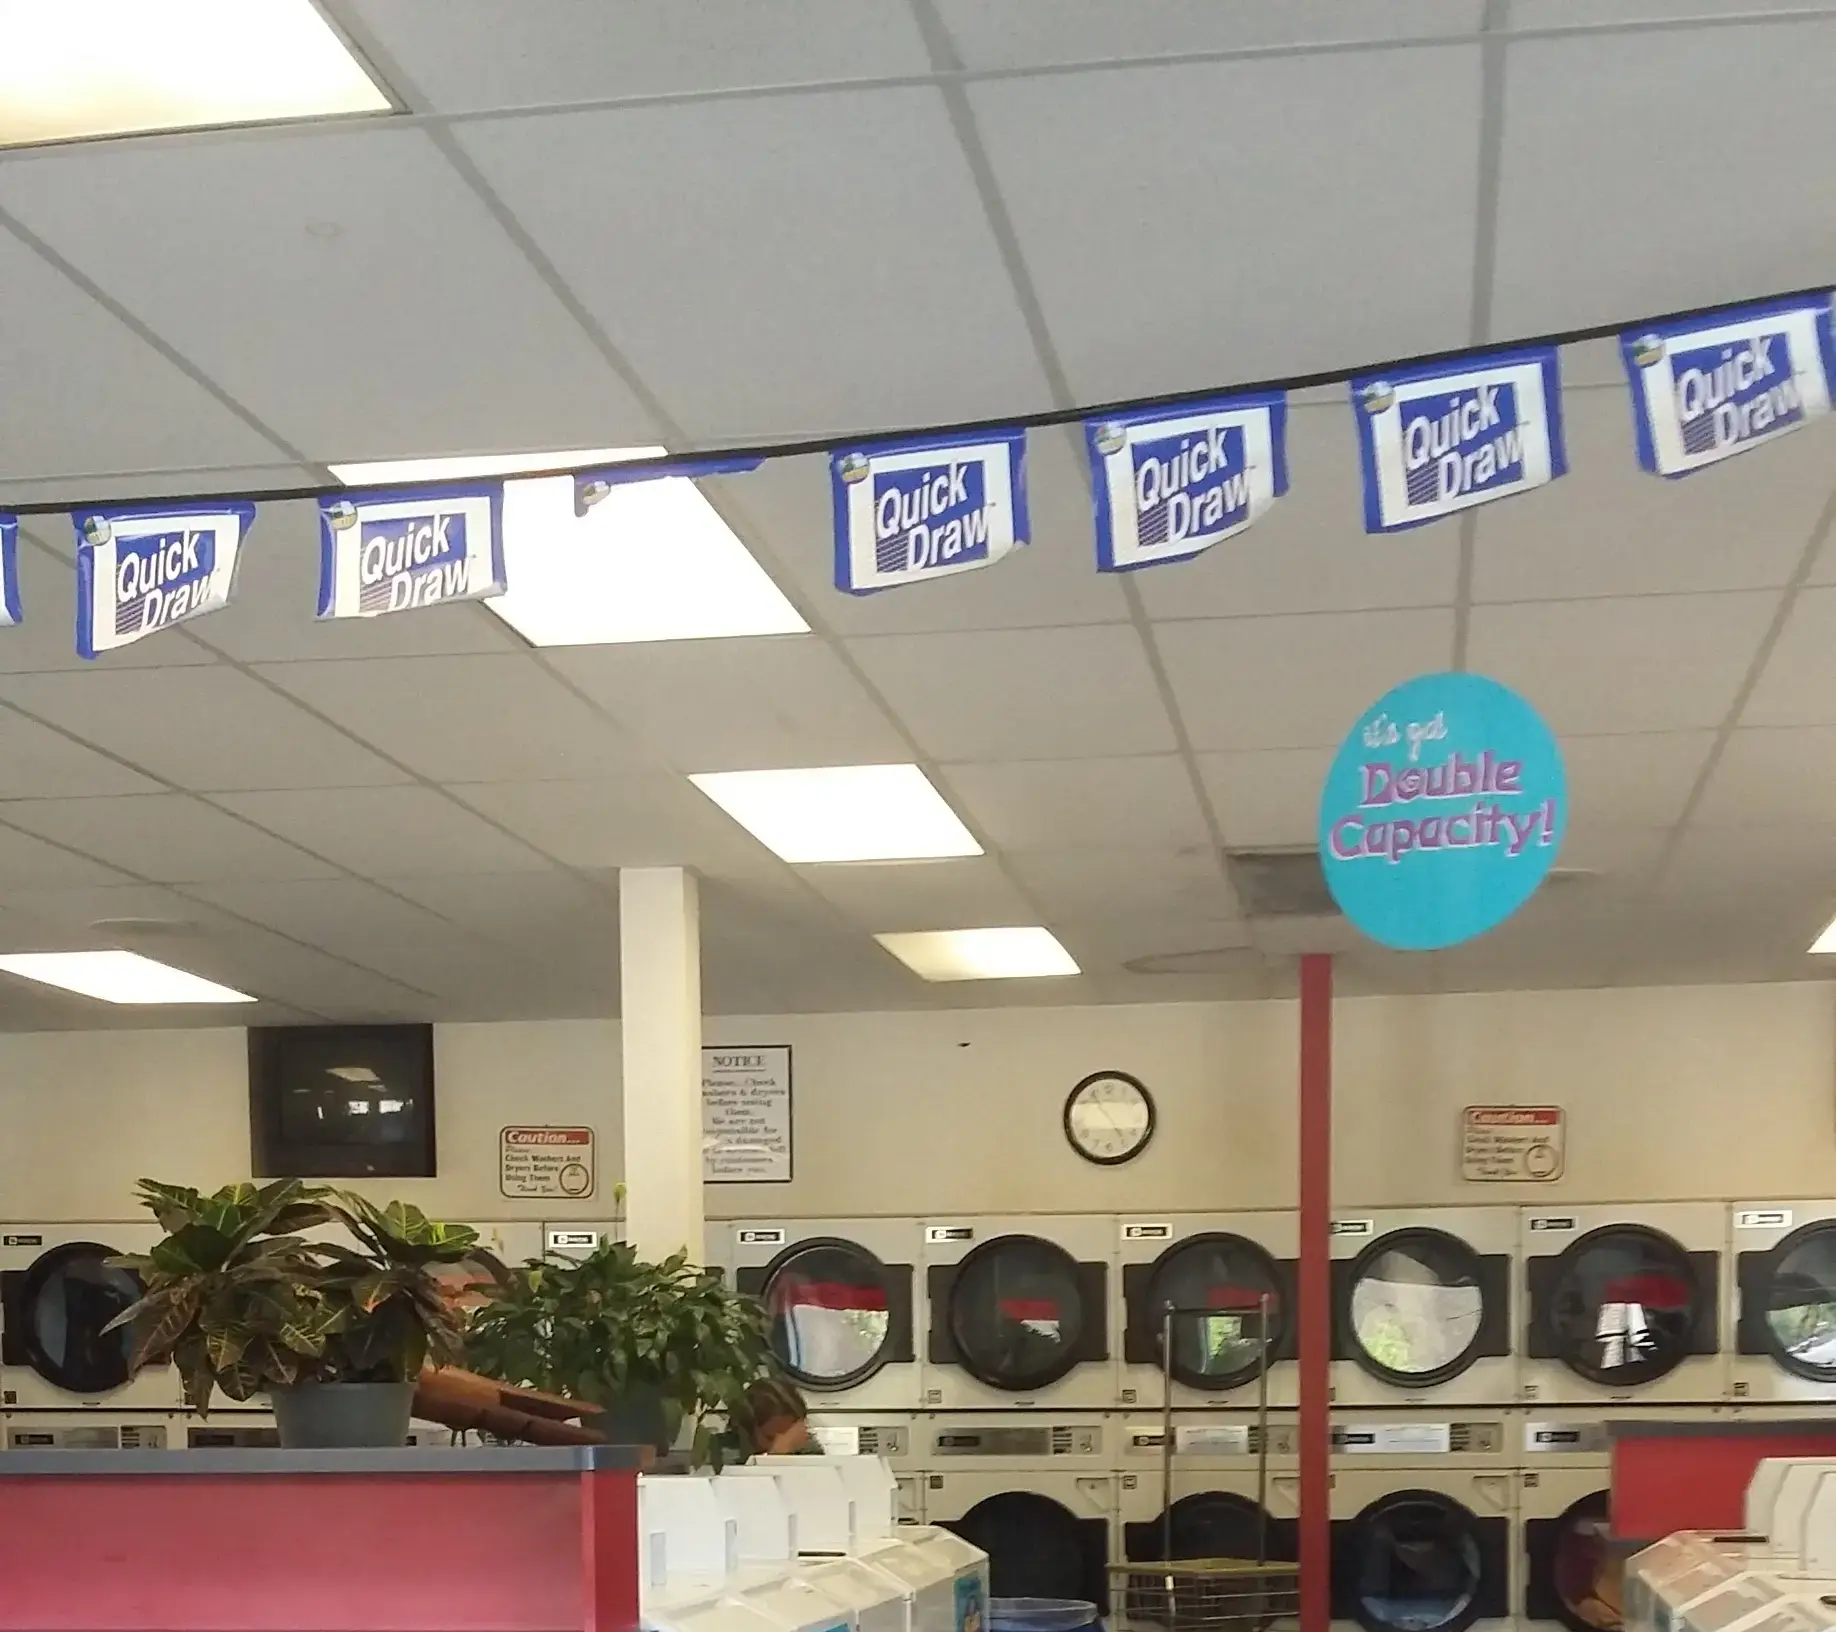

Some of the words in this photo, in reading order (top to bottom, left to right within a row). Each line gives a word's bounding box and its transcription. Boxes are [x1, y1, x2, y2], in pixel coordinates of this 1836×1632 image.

[1677, 336, 1775, 421] Quick
[1713, 371, 1803, 450] Draw
[1405, 385, 1499, 470] Quick
[1437, 423, 1526, 502] Draw
[876, 461, 967, 539] Quick
[1136, 428, 1227, 512] Quick
[1167, 466, 1252, 545] Draw
[118, 528, 200, 602] Quick
[361, 513, 451, 584] Quick
[906, 503, 991, 572] Draw
[139, 567, 215, 631] Draw
[388, 557, 471, 611] Draw
[1363, 712, 1399, 748] it's
[1406, 710, 1448, 762] got
[1357, 749, 1524, 808] Double
[1328, 798, 1558, 865] Capacity!
[712, 1055, 766, 1067] NOTICE
